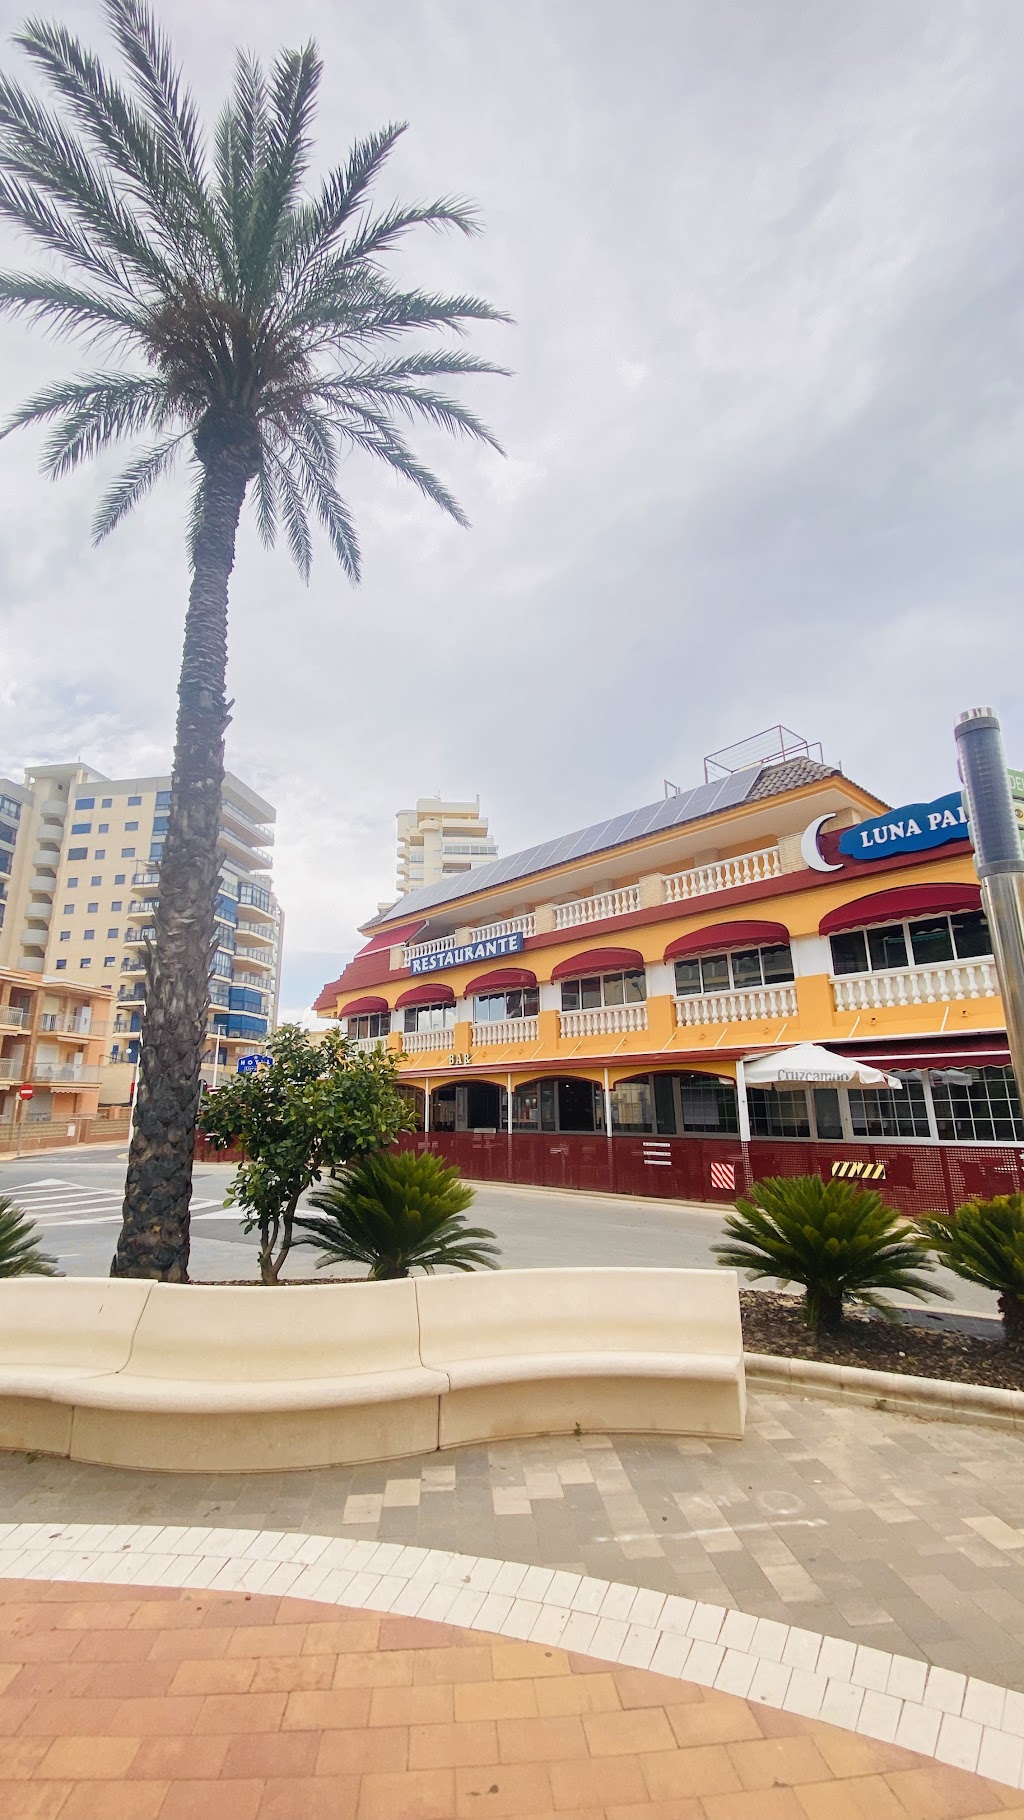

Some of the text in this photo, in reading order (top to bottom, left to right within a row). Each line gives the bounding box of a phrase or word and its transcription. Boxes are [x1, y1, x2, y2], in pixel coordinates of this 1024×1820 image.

[860, 818, 922, 848] LUNA
[412, 935, 518, 973] RESTAURANTE
[449, 1053, 471, 1065] BAR
